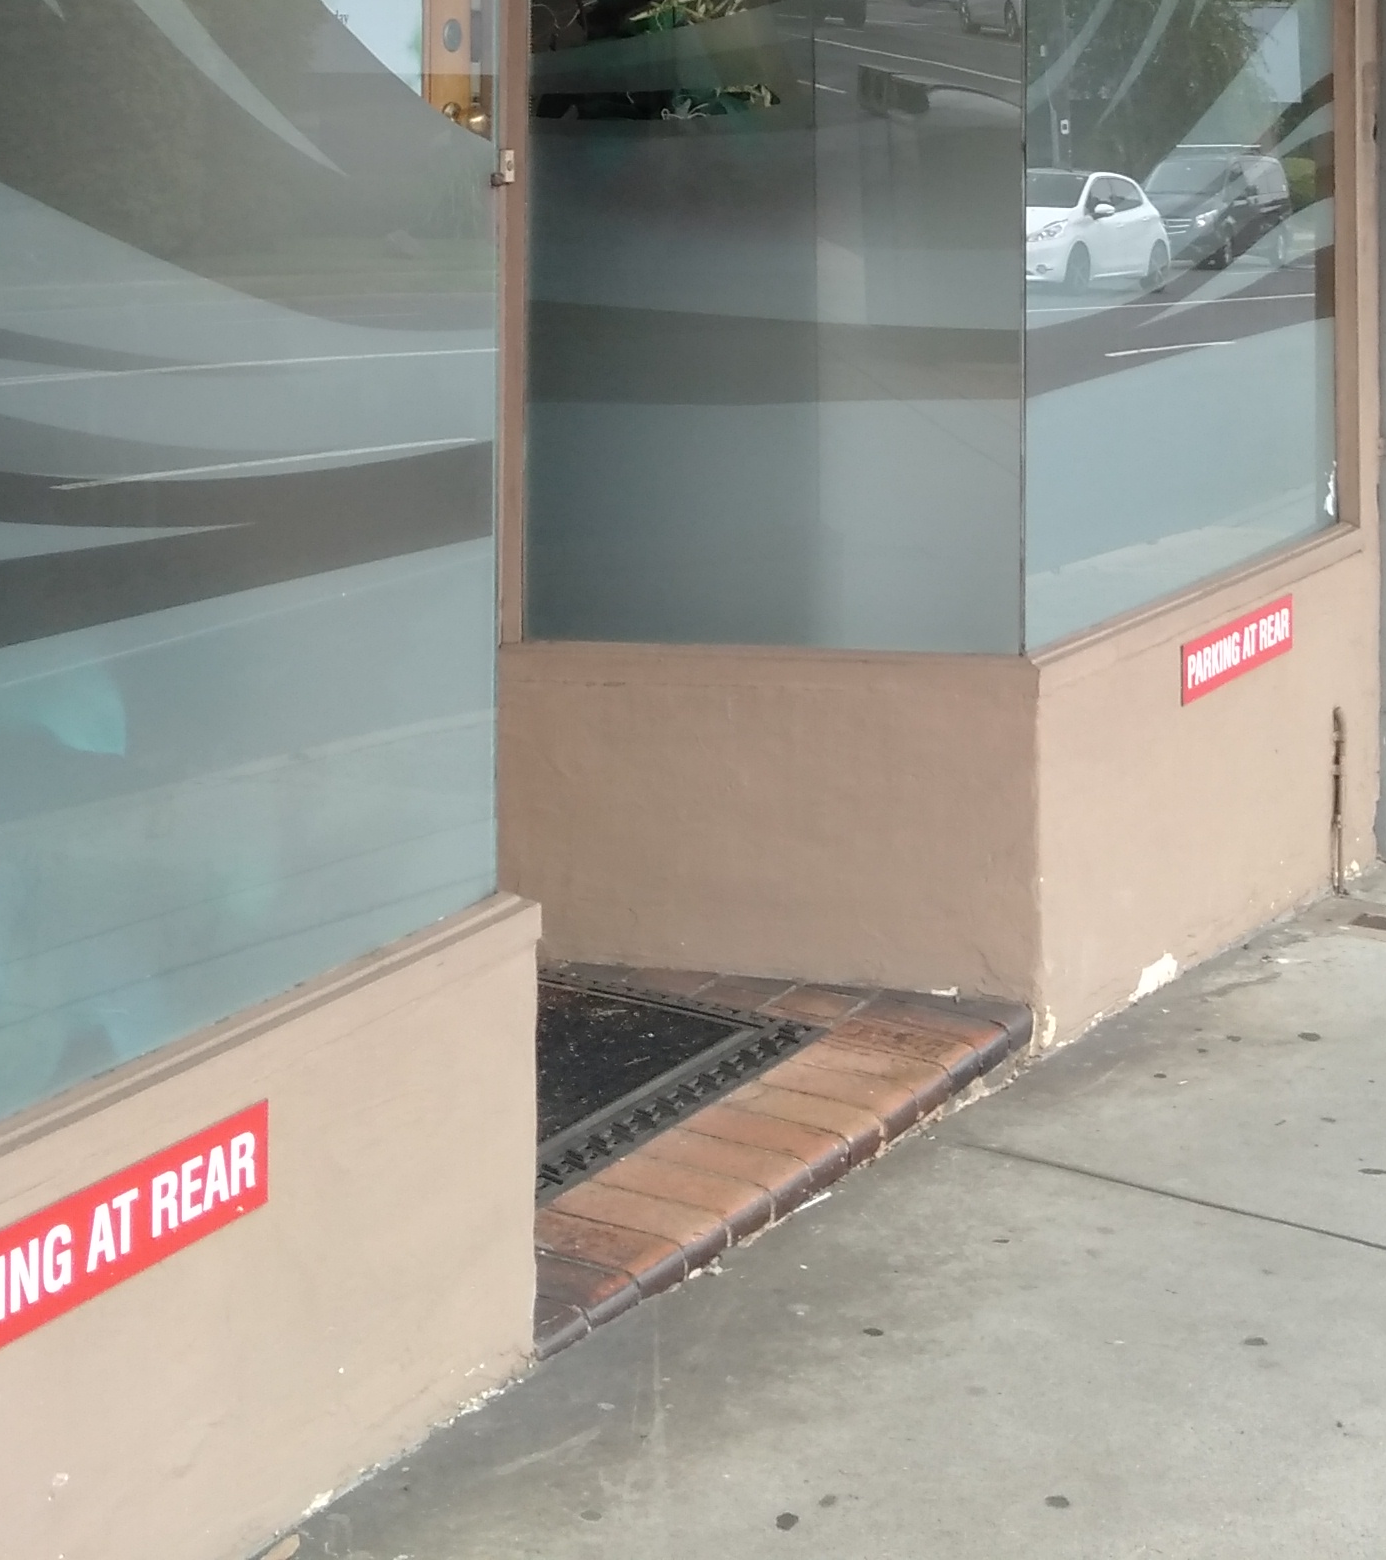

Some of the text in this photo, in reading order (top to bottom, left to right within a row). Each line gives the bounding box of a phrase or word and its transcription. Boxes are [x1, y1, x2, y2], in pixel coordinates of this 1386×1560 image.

[1187, 607, 1291, 690] PARKING AT REAR
[85, 1187, 140, 1274] AT
[150, 1130, 257, 1239] REAR
